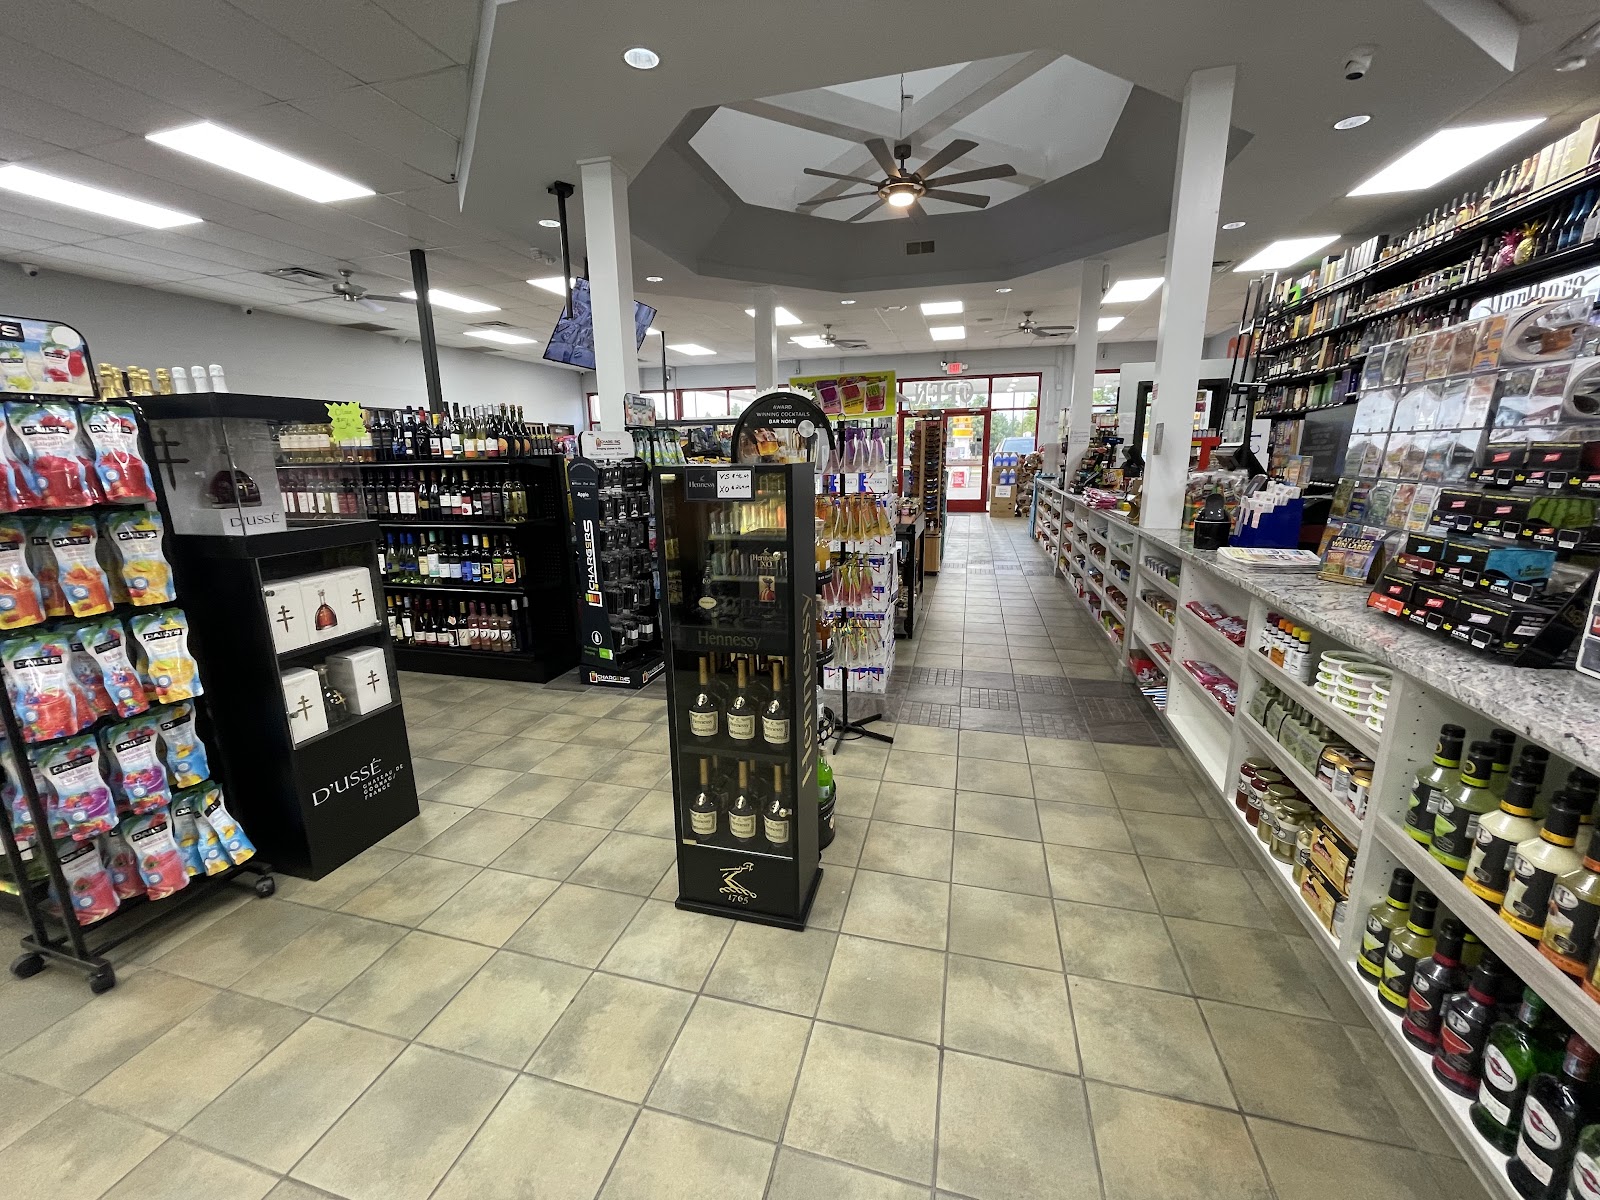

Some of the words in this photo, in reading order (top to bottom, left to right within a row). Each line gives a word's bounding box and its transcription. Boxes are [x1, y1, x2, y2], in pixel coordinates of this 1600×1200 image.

[230, 512, 280, 527] D'USSÉ
[583, 519, 598, 591] CHARGERS
[761, 560, 773, 568] XO
[1444, 572, 1461, 581] EXTRA
[1490, 584, 1509, 594] EXTRA
[1410, 614, 1425, 623] EXTRA
[698, 631, 761, 650] Hennessy
[1451, 629, 1469, 640] EXTRA
[312, 758, 382, 806] D'USSÉ
[362, 770, 393, 789] CHATEAU
[364, 783, 391, 800] FRANCE
[728, 894, 749, 905] 1765
